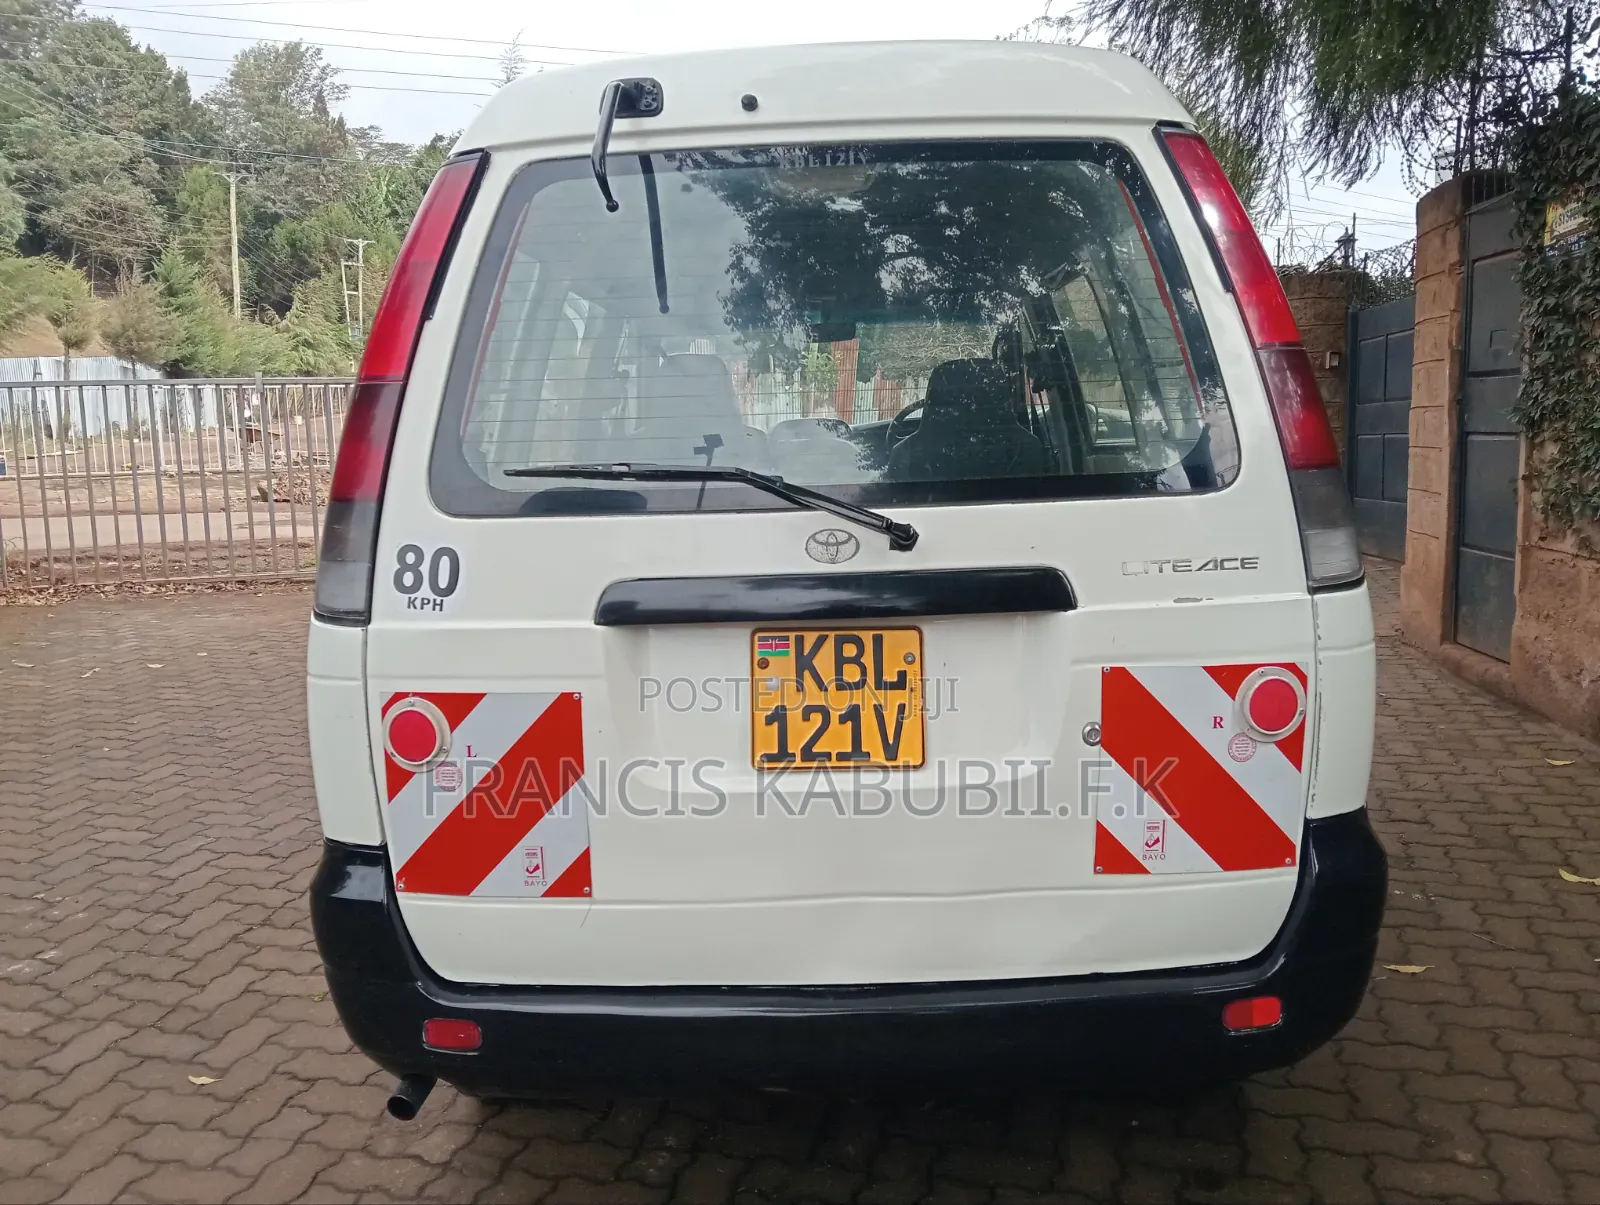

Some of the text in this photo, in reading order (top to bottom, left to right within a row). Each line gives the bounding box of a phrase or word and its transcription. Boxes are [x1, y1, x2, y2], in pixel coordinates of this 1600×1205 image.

[393, 543, 460, 598] 80
[406, 596, 444, 612] KPH
[794, 633, 907, 692] KBL
[1212, 716, 1224, 729] R
[759, 703, 906, 762] 121V
[465, 745, 477, 758] L
[1142, 853, 1166, 861] BAYO
